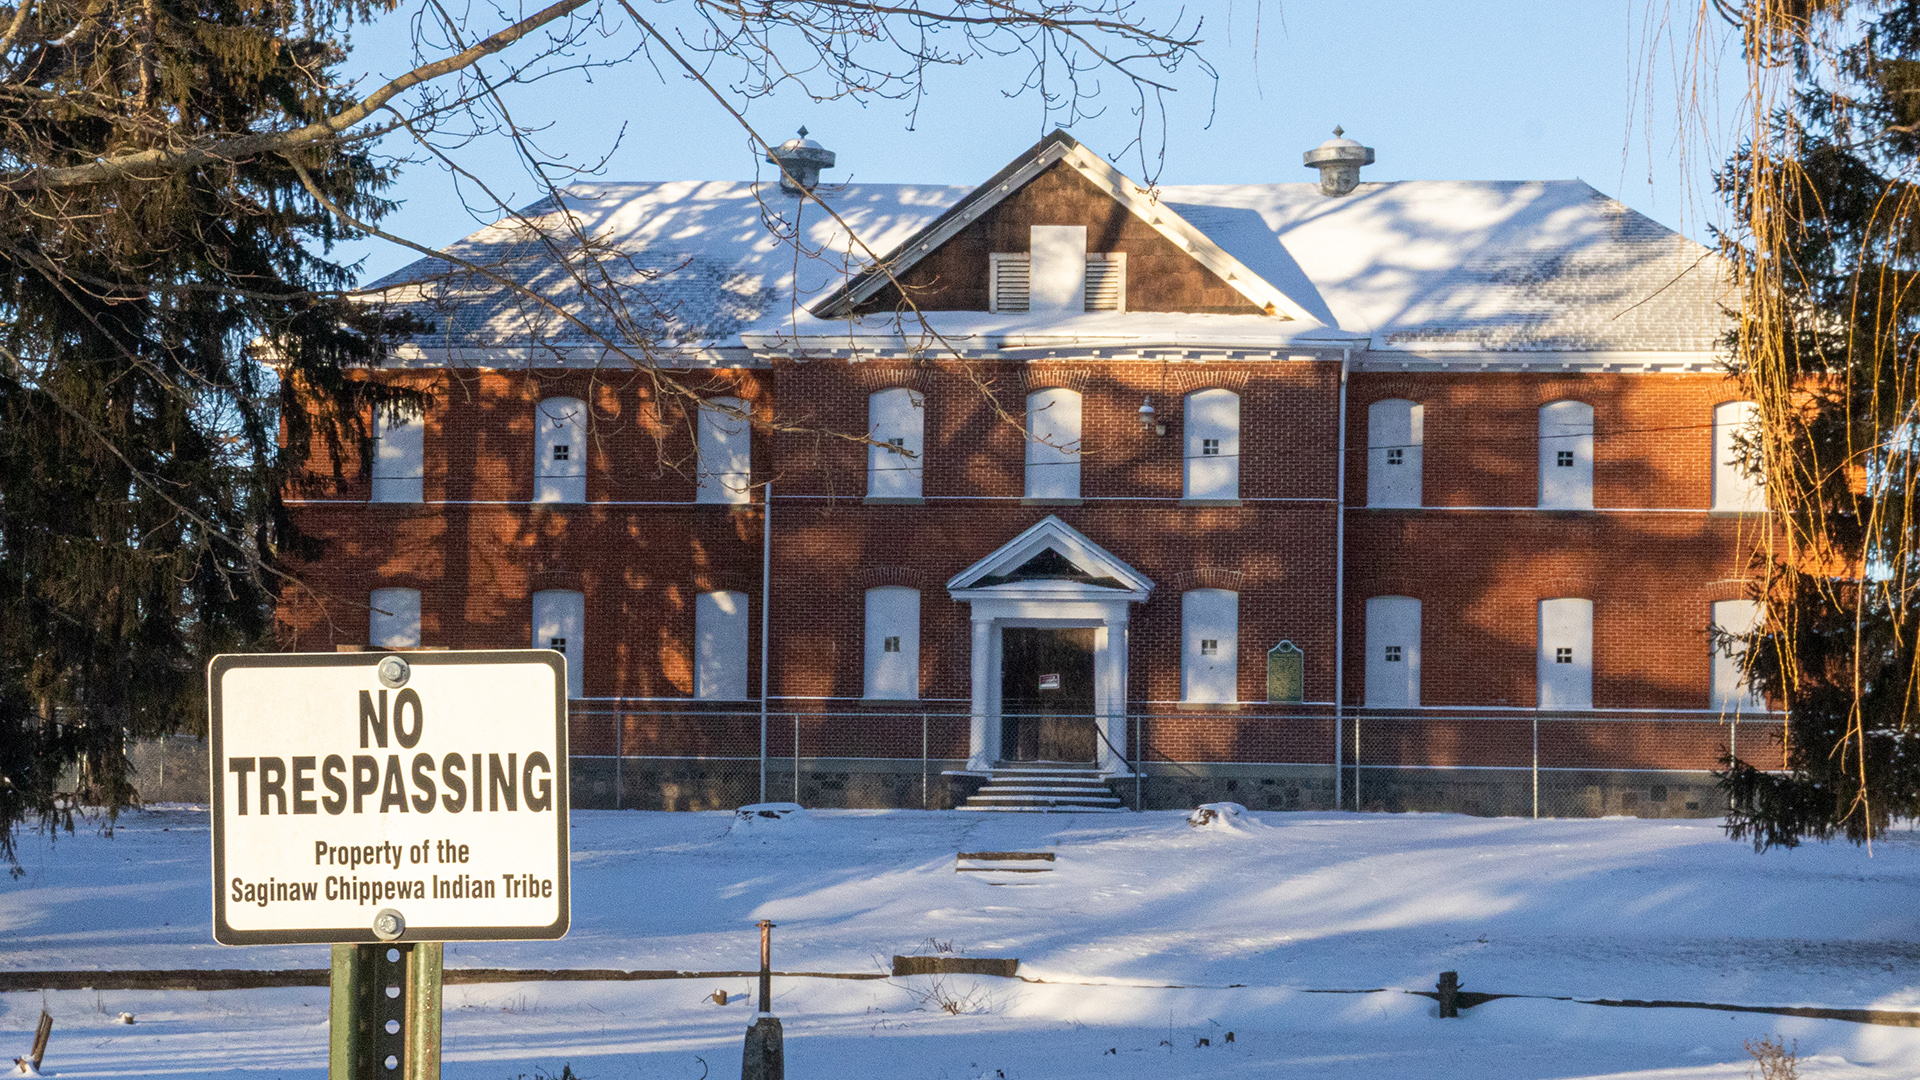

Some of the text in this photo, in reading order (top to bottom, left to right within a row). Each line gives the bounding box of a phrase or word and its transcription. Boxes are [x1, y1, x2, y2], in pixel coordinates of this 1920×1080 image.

[360, 688, 423, 749] NO
[229, 751, 553, 816] TRESPASSING
[315, 839, 470, 870] Property of the
[231, 874, 553, 908] Saginaw Chippewa Indian Tribe
